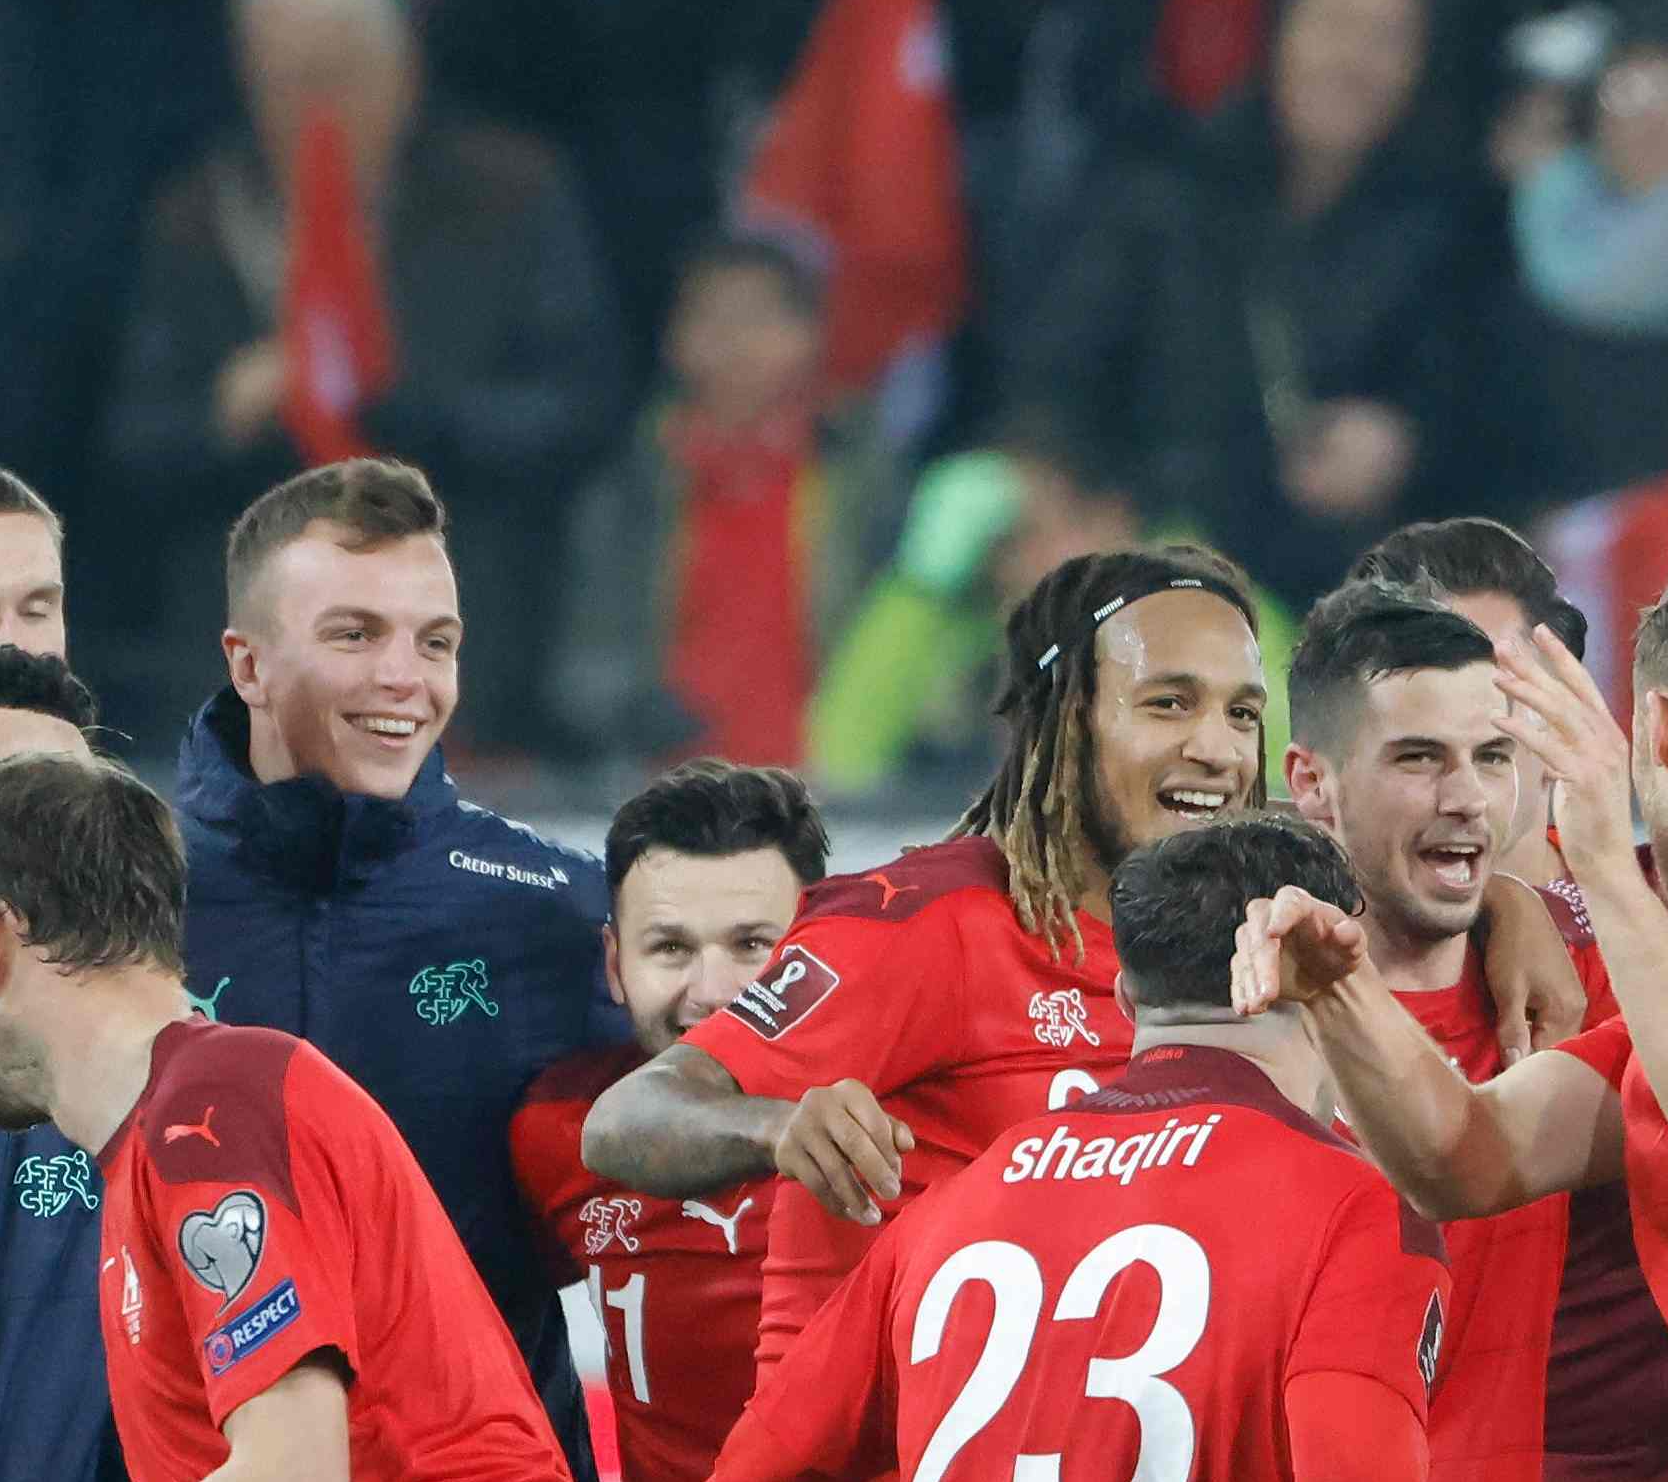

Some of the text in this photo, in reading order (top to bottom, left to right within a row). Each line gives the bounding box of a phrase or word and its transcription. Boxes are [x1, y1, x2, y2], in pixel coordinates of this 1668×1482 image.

[449, 850, 556, 890] CREDIT SUISSE
[1003, 1114, 1222, 1186] shaqiri
[232, 1287, 296, 1348] RESPECT
